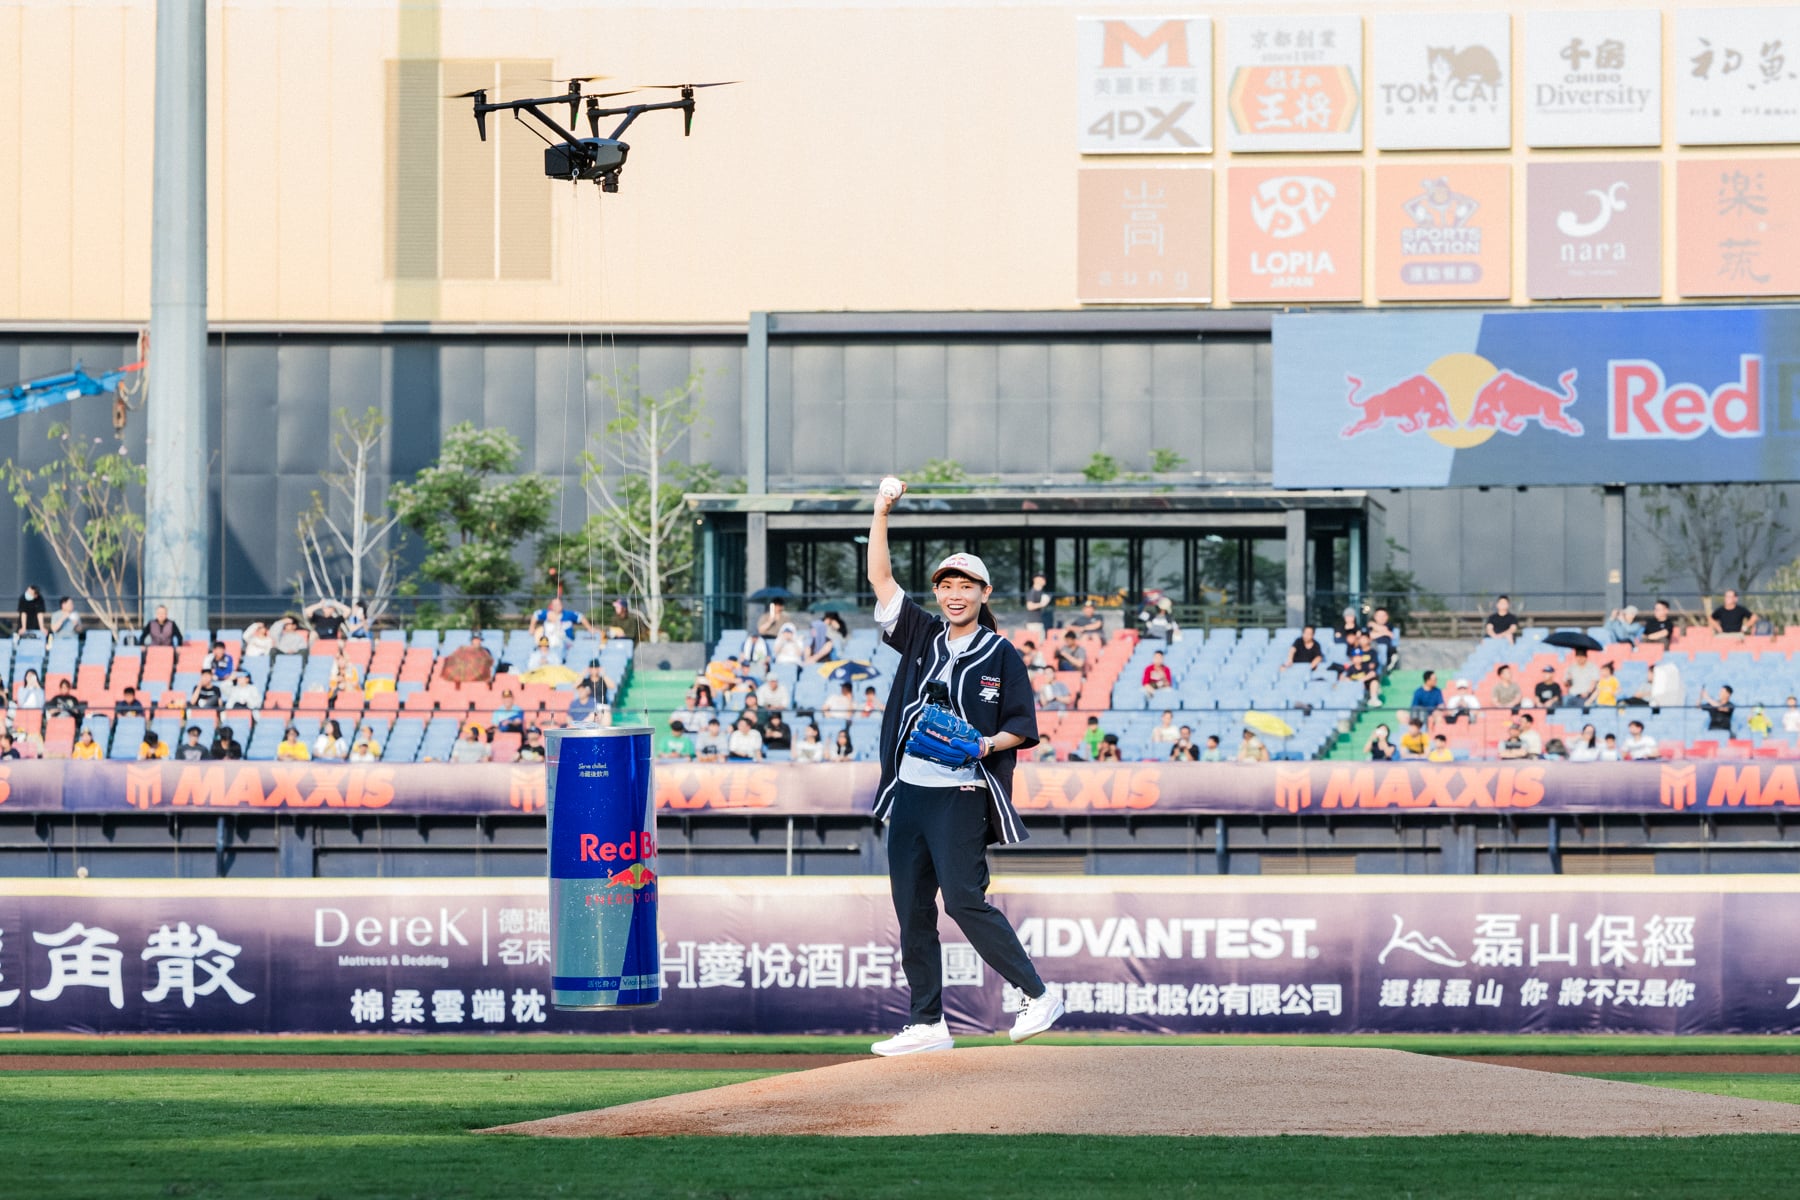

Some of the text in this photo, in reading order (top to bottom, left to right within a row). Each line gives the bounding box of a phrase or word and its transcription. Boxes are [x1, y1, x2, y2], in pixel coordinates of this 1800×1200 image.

[1381, 82, 1503, 103] TOM CAT
[1536, 83, 1652, 113] Diversity
[1088, 102, 1200, 147] 4DX
[1401, 227, 1482, 241] SPORTS
[1402, 241, 1481, 256] NATION
[1250, 250, 1337, 275] LOPIA
[1560, 242, 1627, 263] nara
[1608, 354, 1764, 439] Red
[172, 766, 395, 808] MAXXIS
[1321, 767, 1545, 808] MAXXIS
[580, 831, 637, 862] Red
[1470, 914, 1697, 967] 磊山保經
[0, 921, 256, 1010] 角散
[338, 955, 449, 969] Mattress & Bedding
[350, 988, 548, 1024] 棉柔雲端枕
[1379, 978, 1503, 1007] 選擇磊山
[1520, 978, 1549, 1007] 你
